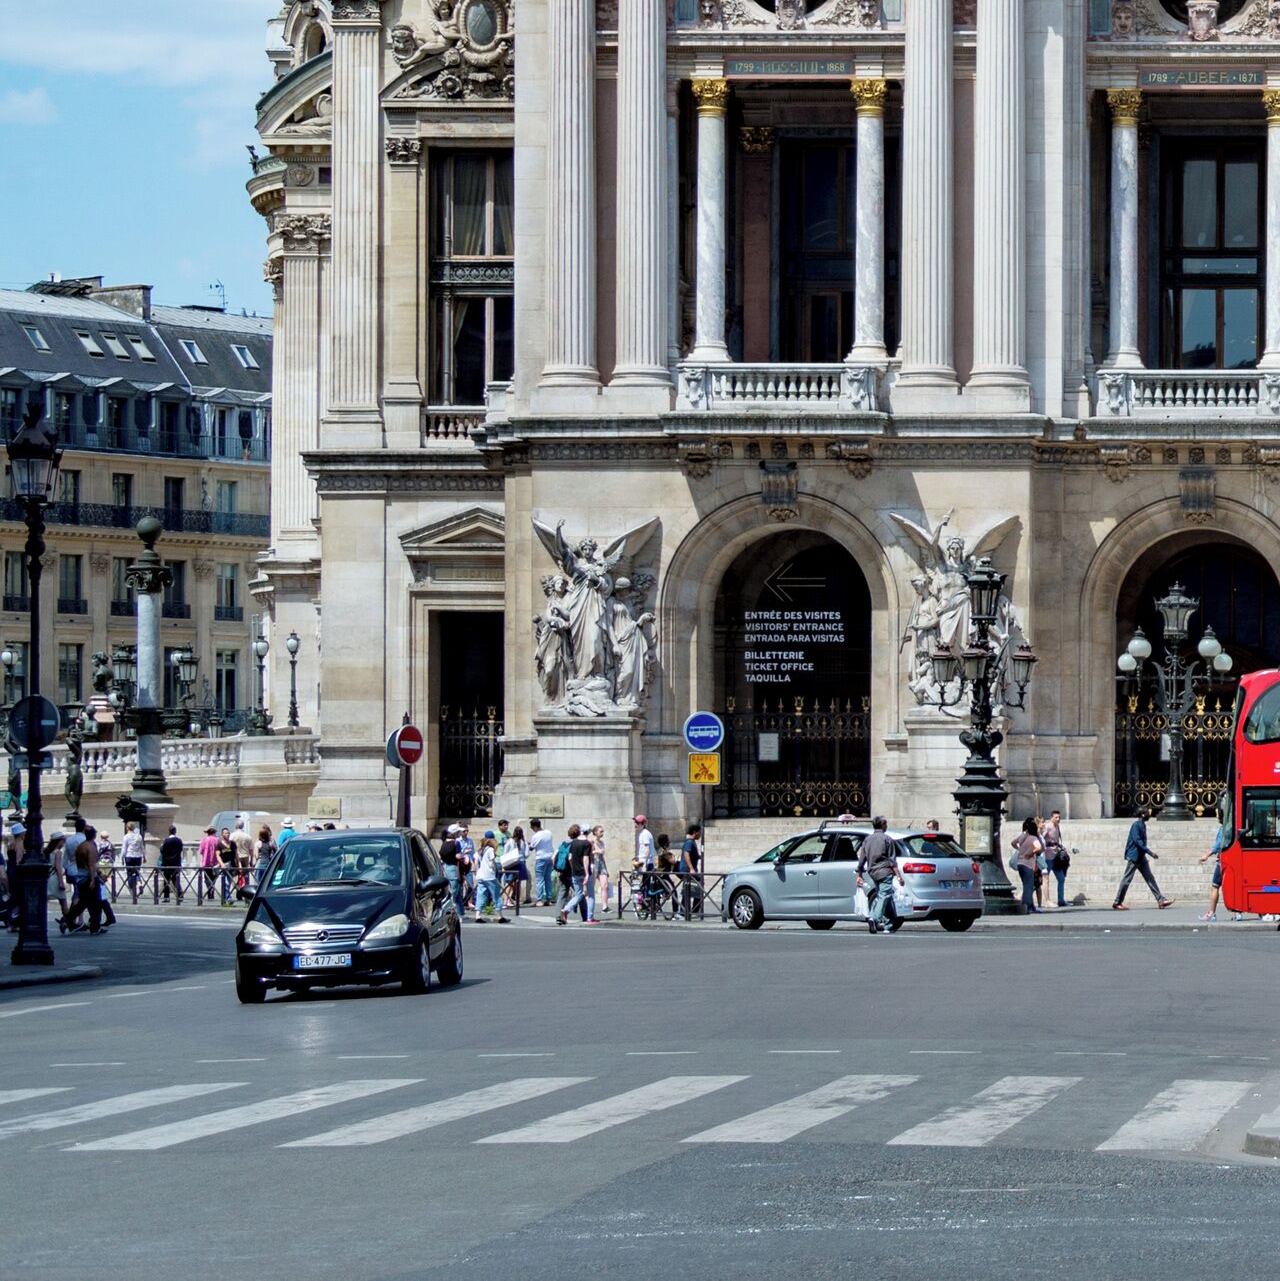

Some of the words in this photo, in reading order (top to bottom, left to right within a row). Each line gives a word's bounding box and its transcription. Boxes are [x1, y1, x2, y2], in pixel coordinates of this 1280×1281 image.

[1175, 71, 1230, 84] AUBER
[1238, 73, 1257, 83] 1871
[744, 609, 782, 620] ENTRÉE
[784, 611, 802, 620] DES
[804, 611, 841, 620] VISITES
[745, 622, 791, 631] VISITORS'
[793, 623, 844, 631] ENTRANCE
[744, 634, 786, 643] ENTRADA
[787, 634, 811, 643] PARA
[812, 634, 845, 643] VISITAS
[744, 651, 805, 660] BILLETTERIE
[745, 663, 779, 671] TICKET
[781, 663, 814, 671] OFFICE
[745, 674, 792, 683] TAQUILLA
